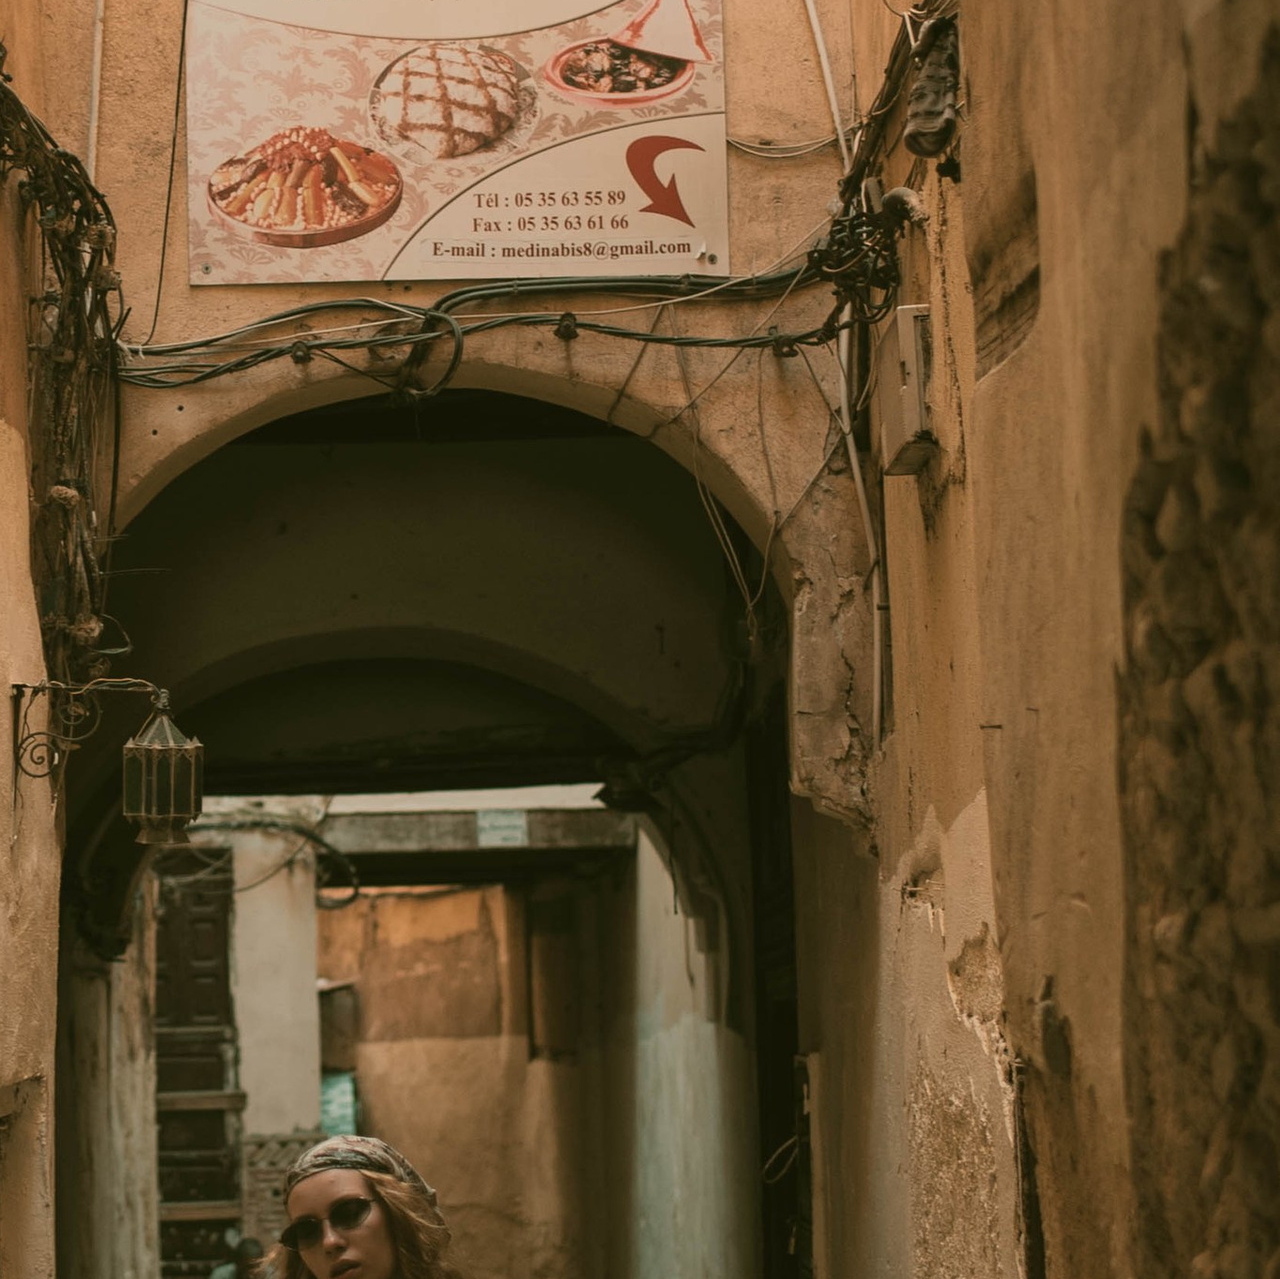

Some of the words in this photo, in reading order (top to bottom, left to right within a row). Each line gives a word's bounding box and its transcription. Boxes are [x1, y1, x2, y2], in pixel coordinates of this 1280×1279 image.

[473, 192, 499, 209] Tél
[514, 192, 533, 208] 05
[537, 192, 556, 207] 35
[561, 192, 579, 207] 63
[584, 191, 603, 206] 55
[607, 190, 626, 205] 89
[473, 217, 502, 233] Fax
[517, 216, 536, 232] 05
[540, 216, 559, 231] 35
[564, 216, 582, 231] 63
[587, 215, 605, 230] 61
[610, 215, 629, 230] 66
[432, 241, 486, 258] E-mail
[501, 239, 692, 262] medinabis8@gmail.com
